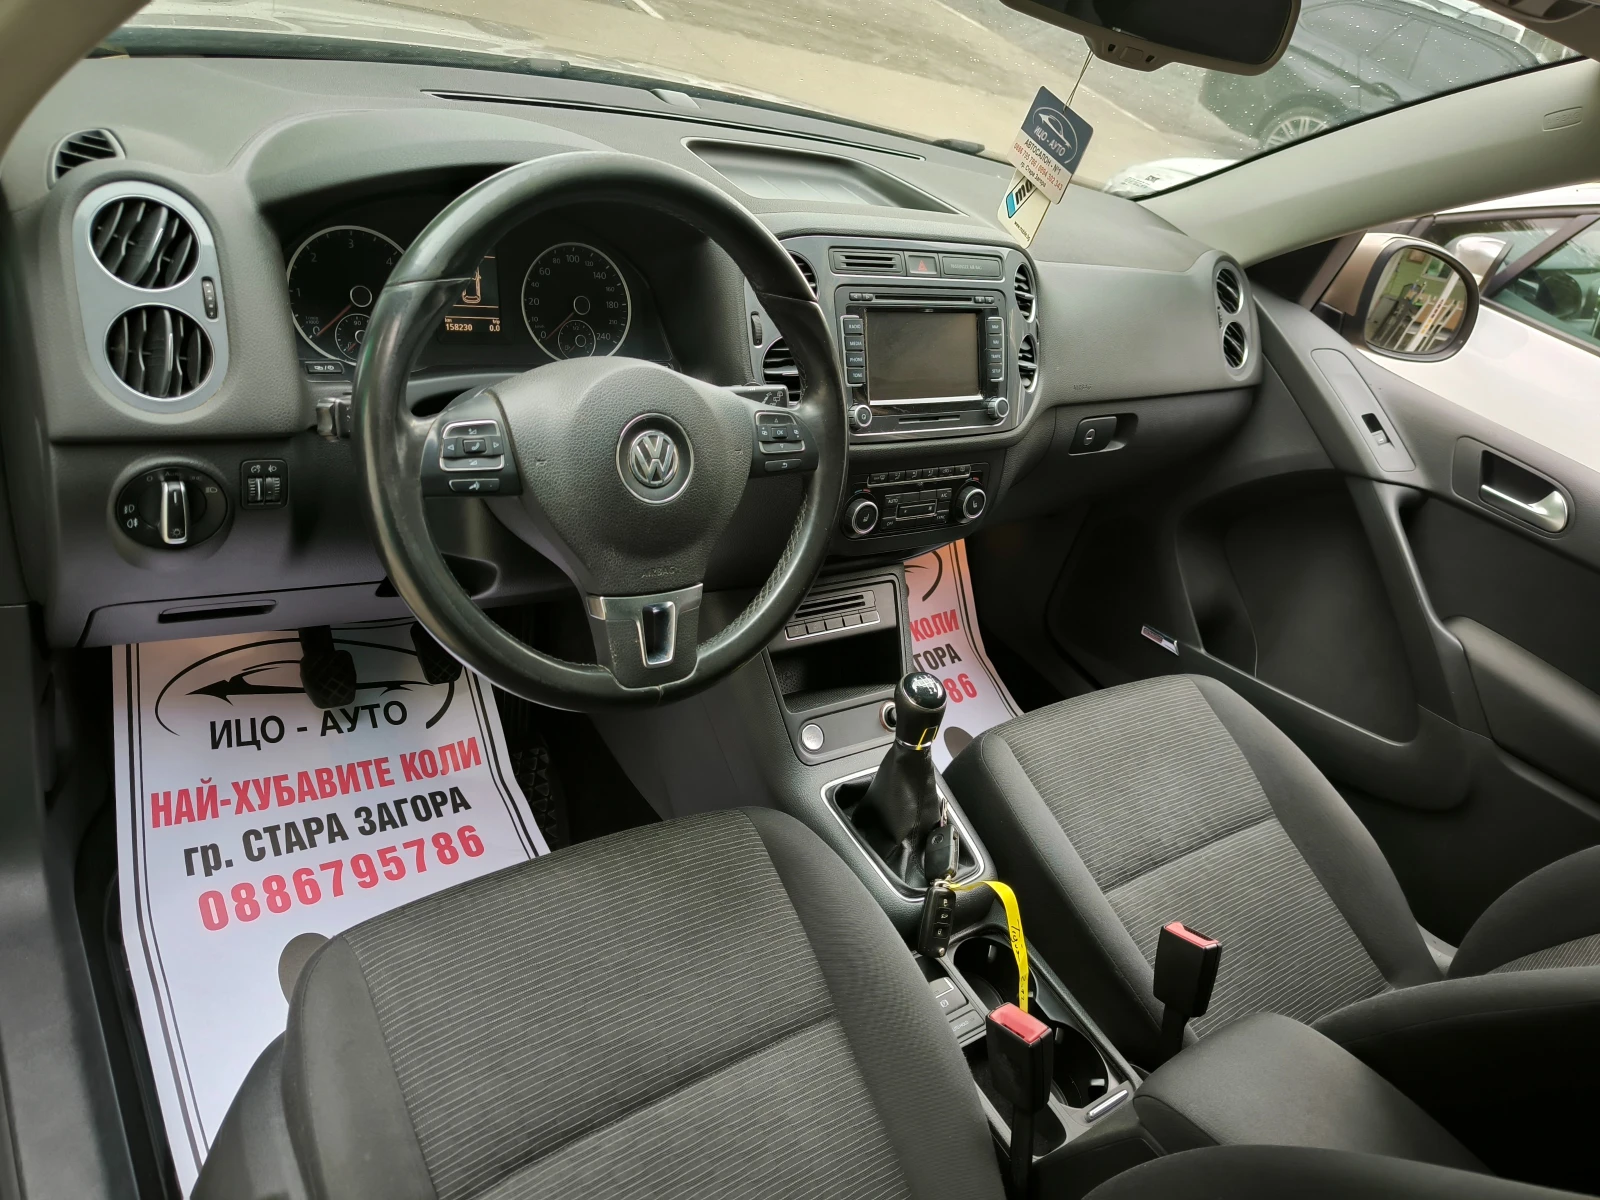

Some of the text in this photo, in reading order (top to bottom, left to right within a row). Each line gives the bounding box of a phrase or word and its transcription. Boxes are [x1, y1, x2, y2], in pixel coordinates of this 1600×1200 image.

[1024, 139, 1052, 166] АВТОСАЛОН
[1034, 126, 1048, 140] ИЦО
[1049, 139, 1066, 156] АУТО
[1015, 179, 1035, 205] mo
[539, 267, 551, 276] 60
[566, 254, 580, 263] 100
[593, 271, 607, 280] 140
[528, 297, 540, 306] 20
[606, 301, 619, 309] 180
[445, 323, 473, 332] 158230
[489, 324, 501, 332] 0.0
[596, 332, 611, 341] 240
[910, 609, 960, 642] КОЛИ
[913, 643, 962, 673] ГОРА
[944, 673, 978, 704] 86
[210, 714, 285, 751] ИЦО
[319, 700, 409, 737] АУТО
[150, 736, 482, 829] НАЙ-ХУБАВИТЕ КОЛИ
[183, 786, 472, 877] гр. СТАРА ЗАГОРА
[198, 824, 486, 932] 0886795786
